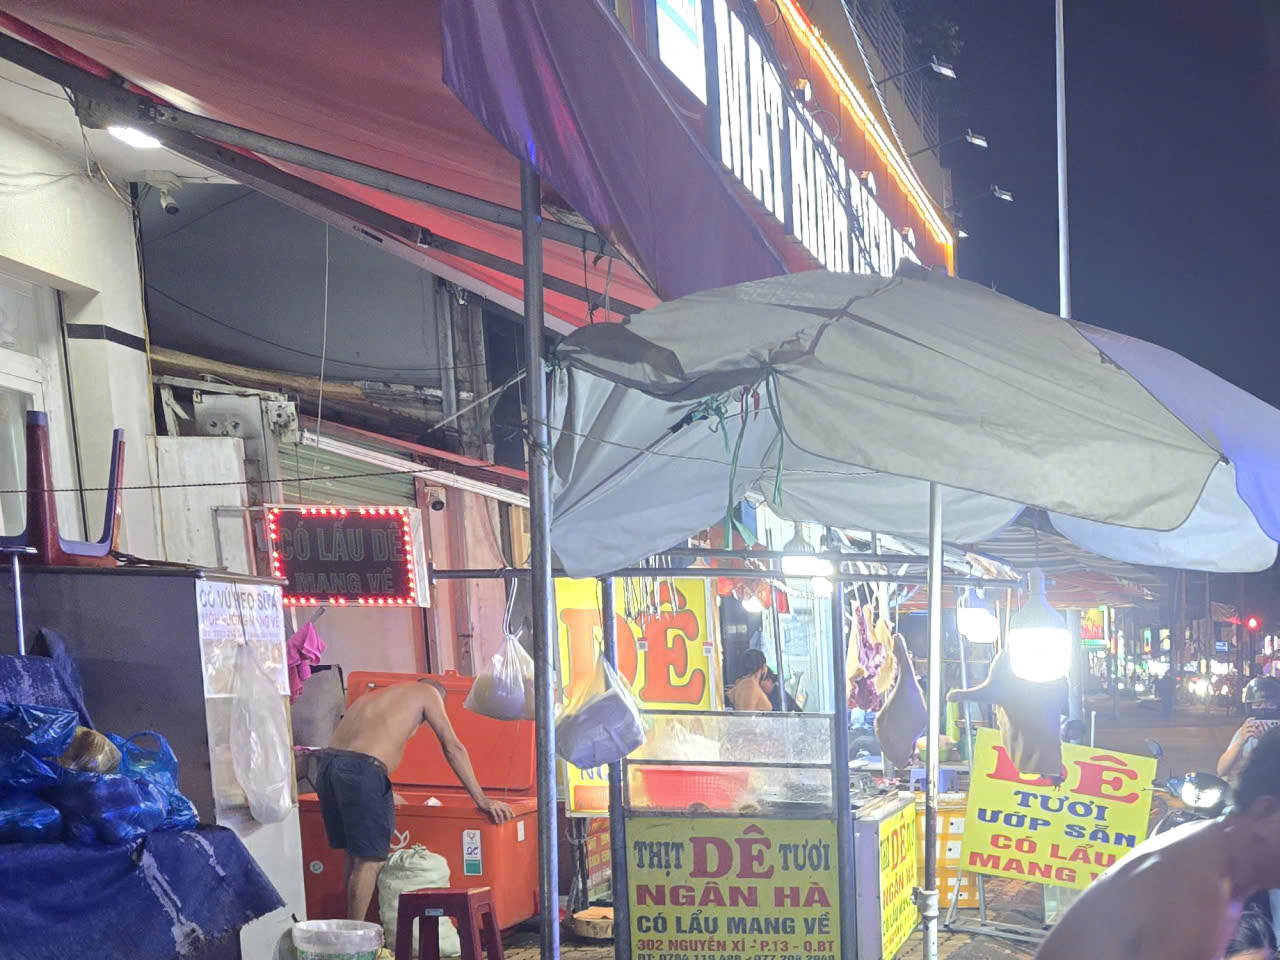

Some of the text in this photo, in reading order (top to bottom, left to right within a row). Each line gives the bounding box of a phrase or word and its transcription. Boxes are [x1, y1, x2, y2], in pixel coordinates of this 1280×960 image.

[371, 521, 406, 562] DÊ
[294, 571, 362, 594] MANG
[1013, 790, 1109, 821] TƯƠI
[977, 807, 1051, 831] ƯỚP
[634, 823, 831, 879] THỊT DÊ TƯƠI
[990, 834, 1037, 854] CÓ
[968, 851, 1078, 883] MANG
[636, 881, 831, 907] NGÂN HÀ
[636, 909, 832, 936] CÓ LẨU MANG VỀ
[637, 939, 664, 951] 302
[668, 936, 727, 952] NGUYỄN
[760, 940, 789, 952] P.13
[803, 940, 836, 953] Q.BT
